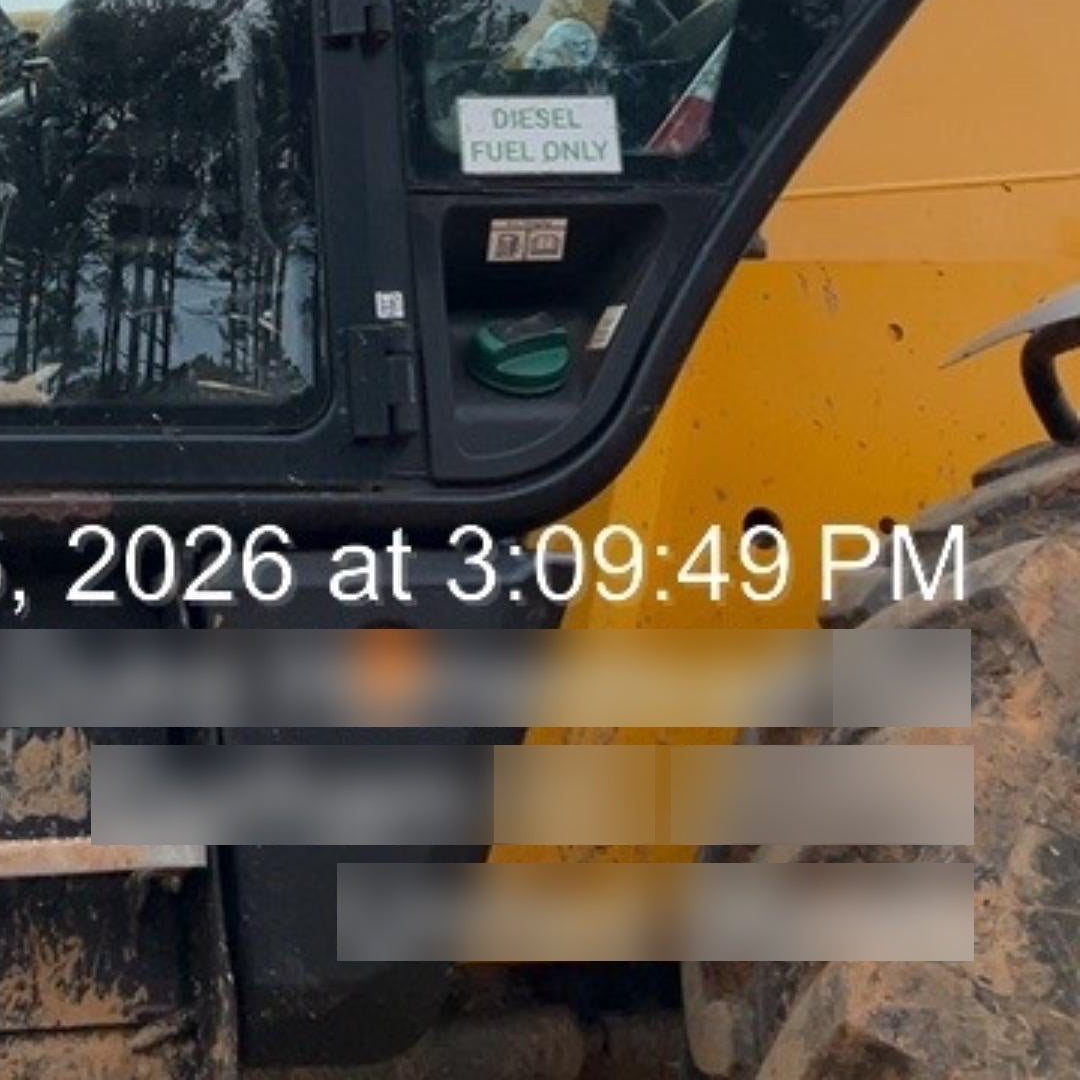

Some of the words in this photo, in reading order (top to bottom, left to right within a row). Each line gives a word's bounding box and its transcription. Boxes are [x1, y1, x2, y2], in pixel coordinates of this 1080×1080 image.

[492, 107, 582, 129] DIESEL
[471, 142, 535, 162] FUEL
[542, 141, 608, 161] ONLY
